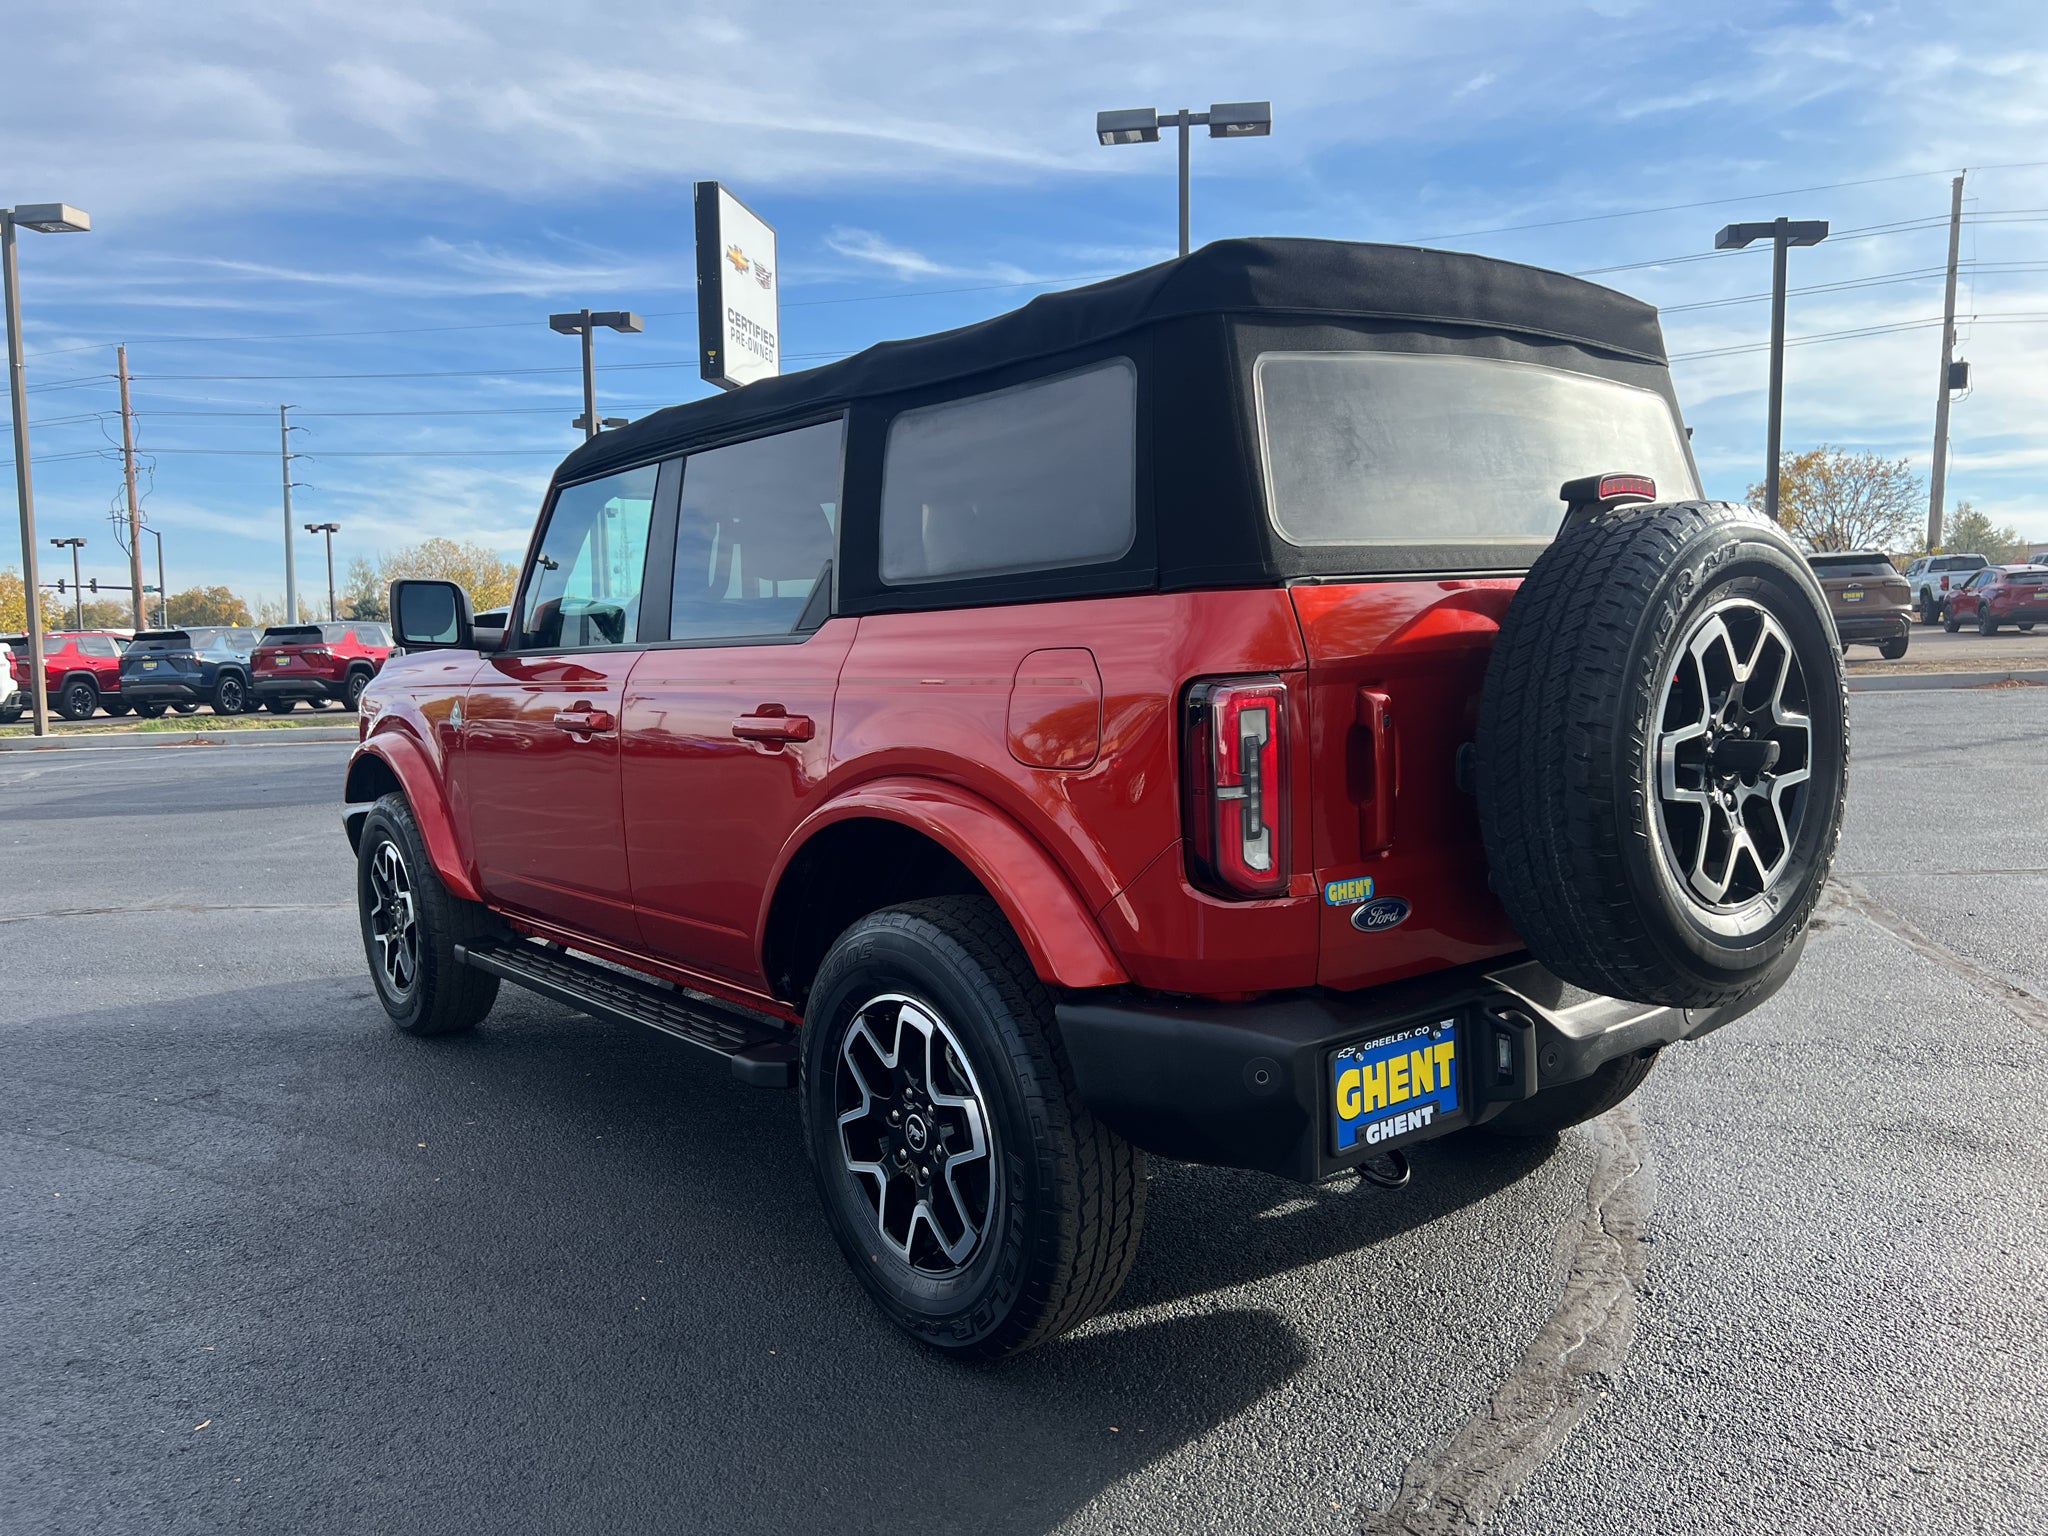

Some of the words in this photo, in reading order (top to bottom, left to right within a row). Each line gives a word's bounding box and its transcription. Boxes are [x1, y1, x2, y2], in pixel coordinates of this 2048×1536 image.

[727, 307, 775, 349] CERTIFIED
[730, 326, 774, 364] PRE-OWNED
[1701, 538, 1742, 578] A/T
[1328, 878, 1372, 902] GHENT
[1367, 906, 1399, 926] Ford
[1414, 1025, 1430, 1037] CO
[1336, 1040, 1455, 1120] GHENT
[1365, 1105, 1434, 1145] GHENT
